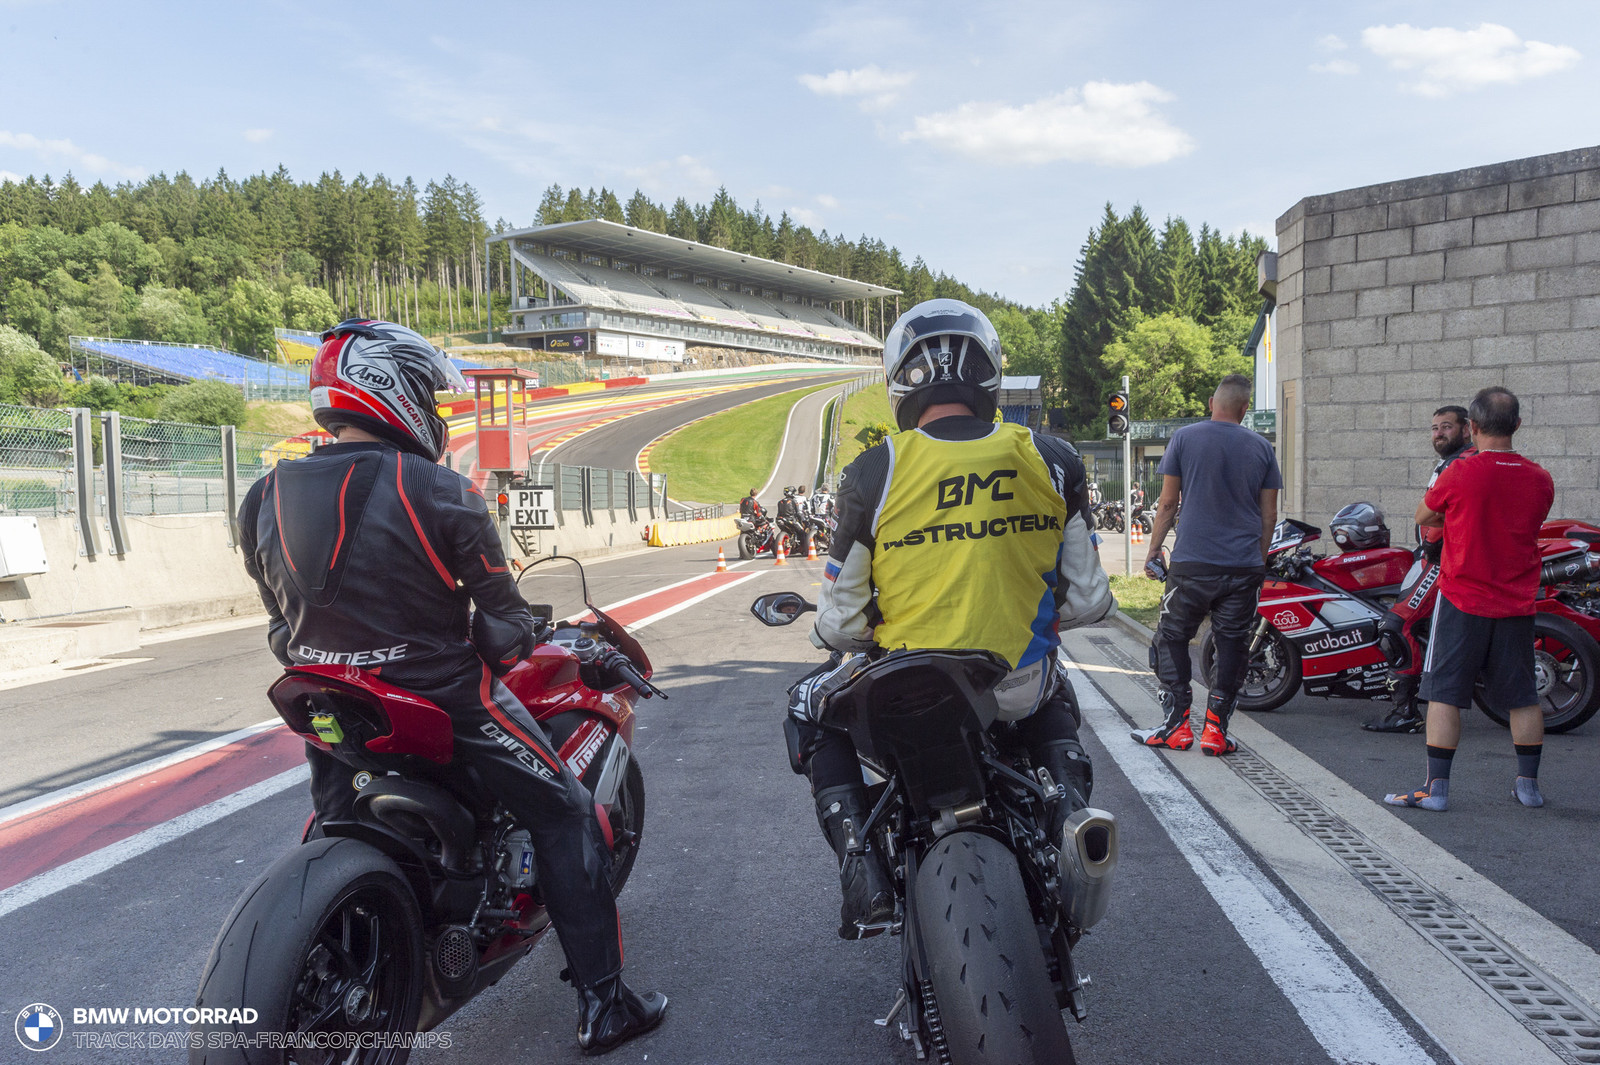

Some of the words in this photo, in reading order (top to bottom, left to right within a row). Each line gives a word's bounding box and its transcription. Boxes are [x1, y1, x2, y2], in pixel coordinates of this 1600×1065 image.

[350, 366, 390, 386] Arai
[397, 394, 423, 428] DUCATI
[519, 491, 543, 507] PIT
[935, 469, 1018, 511] BMC
[515, 509, 549, 525] EXIT
[1343, 555, 1366, 564] DUCATI
[1273, 615, 1300, 626] CLOUD
[1304, 629, 1363, 653] aruba.it
[299, 643, 409, 665] DAINESE
[479, 721, 555, 780] DAINESE
[566, 720, 610, 777] PIRELLI
